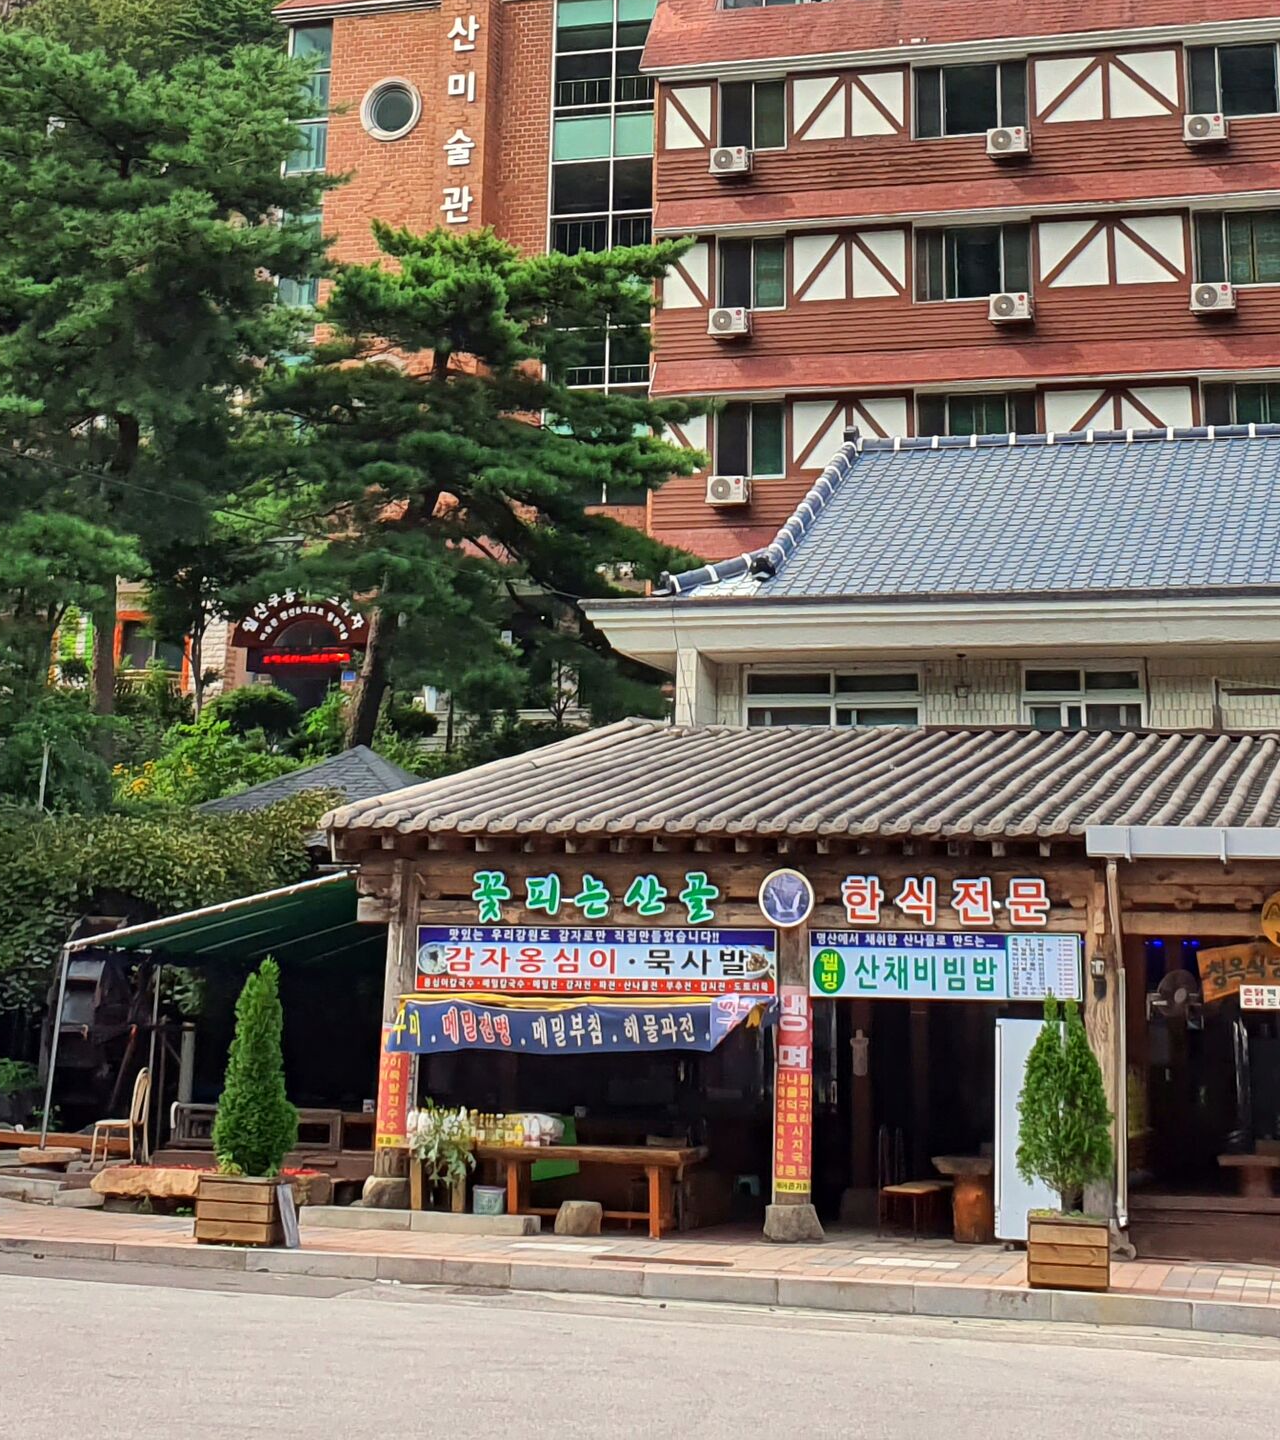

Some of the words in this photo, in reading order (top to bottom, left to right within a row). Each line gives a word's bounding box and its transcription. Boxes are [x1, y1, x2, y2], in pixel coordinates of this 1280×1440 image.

[449, 928, 484, 941] 맛있는
[491, 928, 551, 941] 우리강원도
[559, 929, 607, 942] 감자로만
[816, 932, 859, 946] 명산에서
[865, 933, 898, 946] 채취한
[903, 933, 947, 947] 산나물로
[644, 948, 749, 976] 묵사발
[854, 955, 998, 991] 산채비빔밥
[441, 1006, 512, 1046] 메밀전병
[532, 1012, 603, 1048] 메밀부침
[623, 1012, 696, 1045] 해물파전
